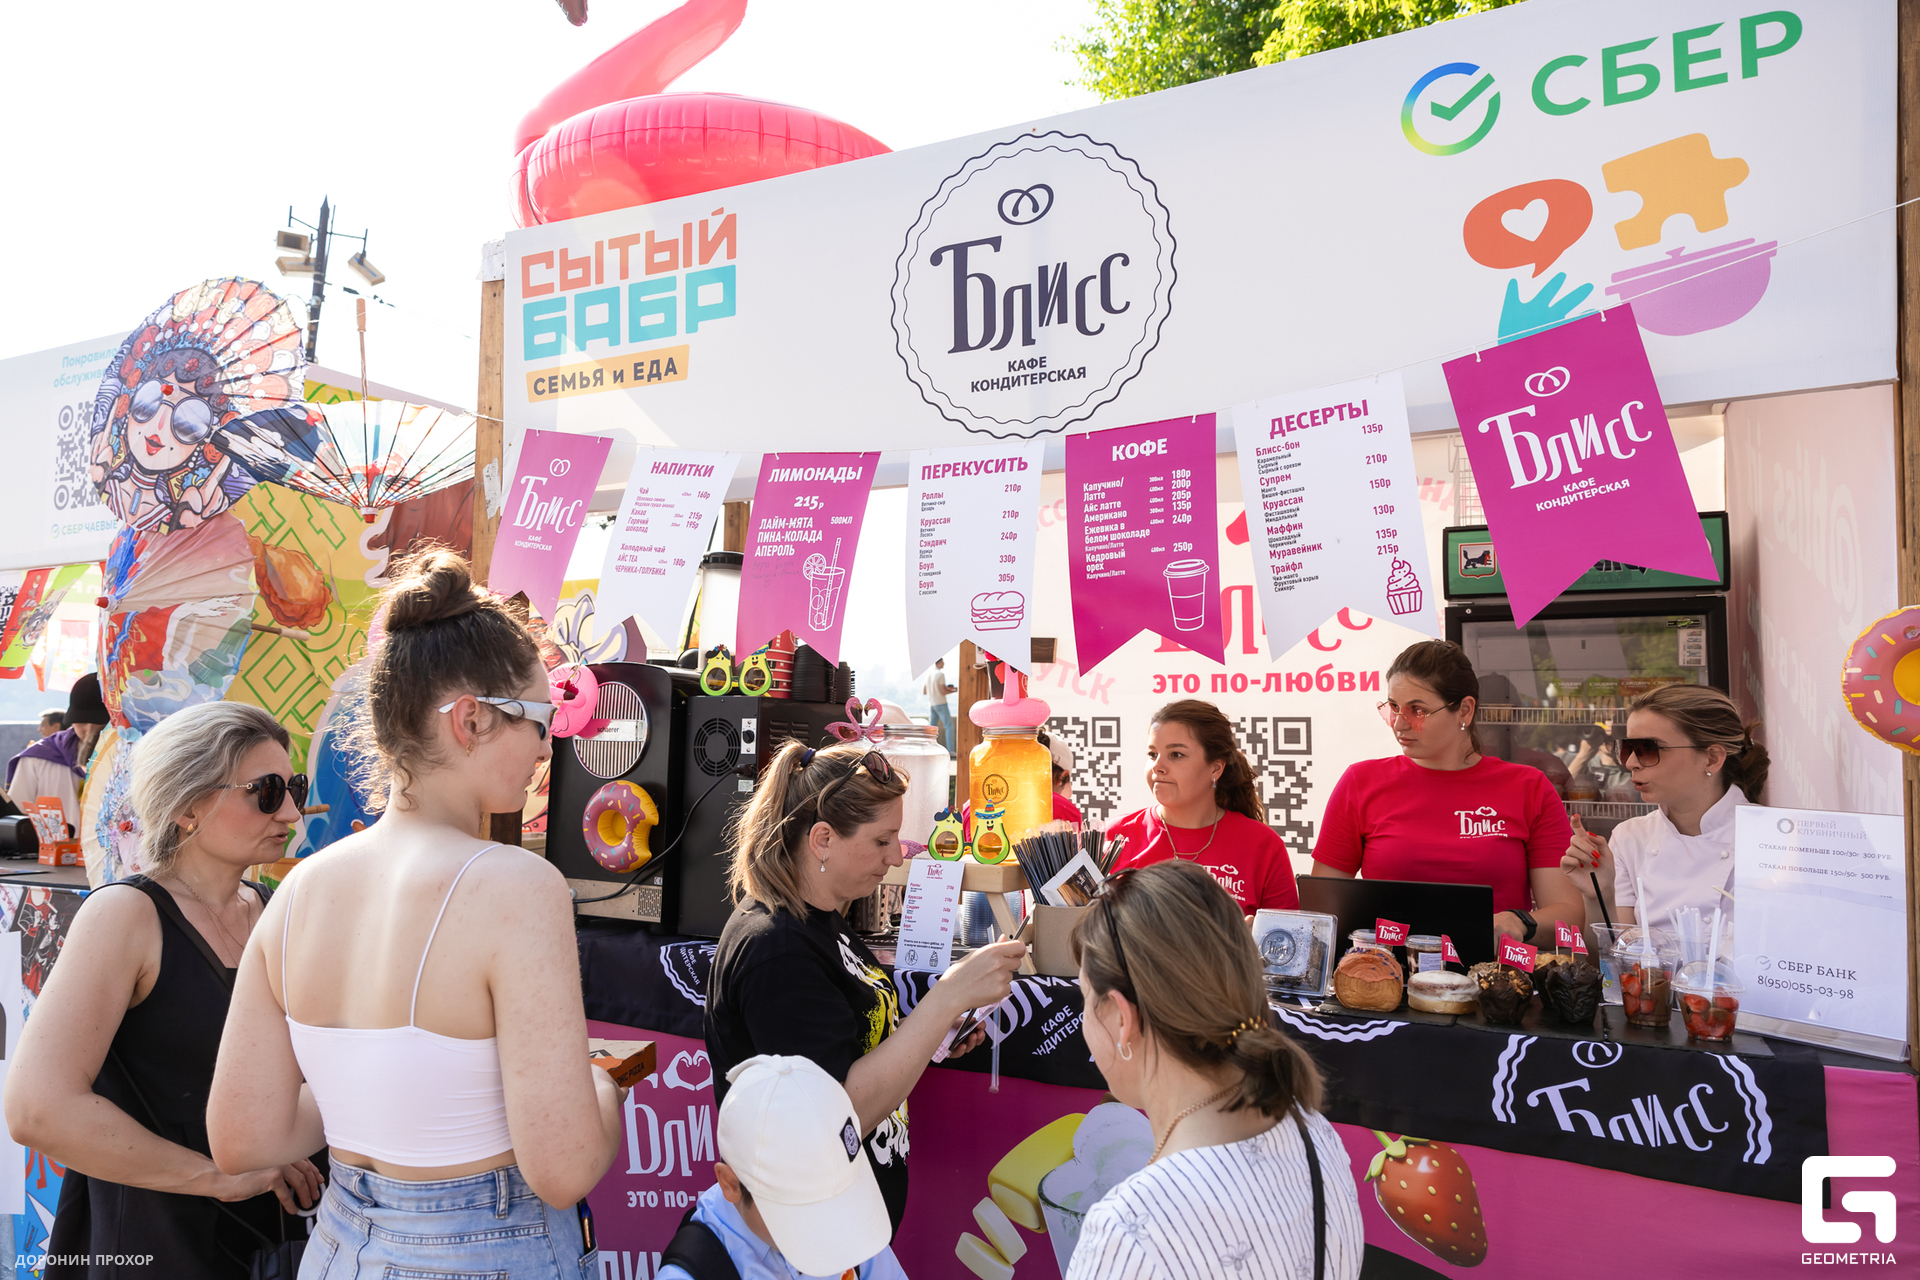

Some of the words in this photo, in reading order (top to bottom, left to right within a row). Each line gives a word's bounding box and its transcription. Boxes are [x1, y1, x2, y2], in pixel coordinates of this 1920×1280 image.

[1531, 10, 1803, 116] СБЕР
[521, 207, 737, 299] СЫТЫЙ
[930, 235, 1130, 354] Блисс
[523, 264, 736, 361] БАБР
[62, 348, 118, 368] Понравило
[1008, 356, 1047, 372] КАФЕ
[534, 368, 604, 396] СЕМЬЯ
[613, 369, 624, 383] и
[634, 357, 678, 382] ЕДА
[971, 366, 1086, 392] КОНДИТЕРСКАЯ
[1270, 399, 1369, 439] ДЕСЕРТЫ
[1112, 438, 1167, 461] КОФЕ
[1256, 441, 1300, 456] Блисс-бон
[1362, 423, 1383, 434] 135р
[1478, 401, 1652, 489] Блисс
[651, 462, 714, 477] НАПИТКИ
[768, 467, 862, 483] ЛИМОНАДЫ
[922, 457, 1028, 480] ПЕРЕКУСИТЬ
[1260, 473, 1291, 487] Супрем
[1366, 454, 1388, 465] 210р
[1005, 484, 1021, 492] 210р
[1084, 477, 1124, 492] Капучино/
[1172, 469, 1191, 479] 180р
[1084, 492, 1105, 501] Латте
[1172, 479, 1191, 489] 200р
[1563, 477, 1595, 493] КАФЕ
[513, 475, 582, 533] Блисс
[697, 491, 710, 500] 160р
[1084, 503, 1098, 513] Айс
[1100, 501, 1121, 510] латте
[1172, 490, 1191, 500] 205р
[1263, 496, 1303, 511] Круассан
[1370, 478, 1391, 489] 150р
[1536, 479, 1630, 511] КОНДИТЕРСКАЯ
[689, 512, 702, 521] 215р
[759, 516, 813, 529] ЛАЙМ-МЯТА
[921, 517, 950, 527] Круассан
[1002, 510, 1019, 518] 210р
[1084, 511, 1127, 523] Американо
[1172, 501, 1191, 511] 135р
[1267, 522, 1303, 535] Маффин
[1373, 504, 1394, 515] 130р
[62, 524, 83, 535] СБЕР
[85, 520, 117, 532] ЧАЕВЫЕ
[628, 517, 649, 525] Горячий
[686, 521, 699, 530] 195р
[1085, 524, 1118, 535] Ежевика
[1172, 514, 1192, 524] 240р
[515, 540, 552, 551] КОНДИТЕРСКАЯ
[757, 530, 822, 543] ПИНА-КОЛАДА
[920, 539, 946, 547] Сэндвич
[1001, 532, 1017, 540] 240р
[1085, 534, 1108, 544] белом
[1110, 529, 1150, 541] шоколаде
[1269, 543, 1322, 560] Муравейник
[1376, 529, 1397, 539] 135р
[620, 543, 652, 552] Холодный
[755, 545, 795, 556] АПЕРОЛЬ
[1086, 549, 1125, 562] Кедровый
[1173, 542, 1192, 552] 250р
[615, 565, 666, 575] ЧЕРНИКА-ГОЛУБИКА
[617, 553, 627, 561] АЙС
[673, 559, 685, 567] 180р
[919, 562, 934, 571] Боул
[1000, 555, 1015, 564] 330р
[1087, 563, 1104, 573] орех
[1271, 562, 1303, 575] Трайфл
[1377, 544, 1399, 555] 215р
[919, 581, 934, 589] Боул
[998, 574, 1014, 582] 305р
[1036, 657, 1116, 706] УТСК
[1152, 674, 1200, 694] это
[1211, 663, 1380, 694] по-любви
[1454, 810, 1505, 835] Блисс
[1797, 820, 1836, 829] ПЕРВЫЙ
[1797, 829, 1867, 840] КЛУБНИЧНЫЙ
[1778, 960, 1812, 974] СБЕР
[1817, 965, 1857, 981] БАНК
[1757, 975, 1854, 999] 8(950)055-03-98
[1041, 1005, 1073, 1035] КАФЕ
[1032, 1012, 1084, 1056] НДИТЕРС
[624, 1073, 715, 1176] Бли
[627, 1191, 658, 1208] это
